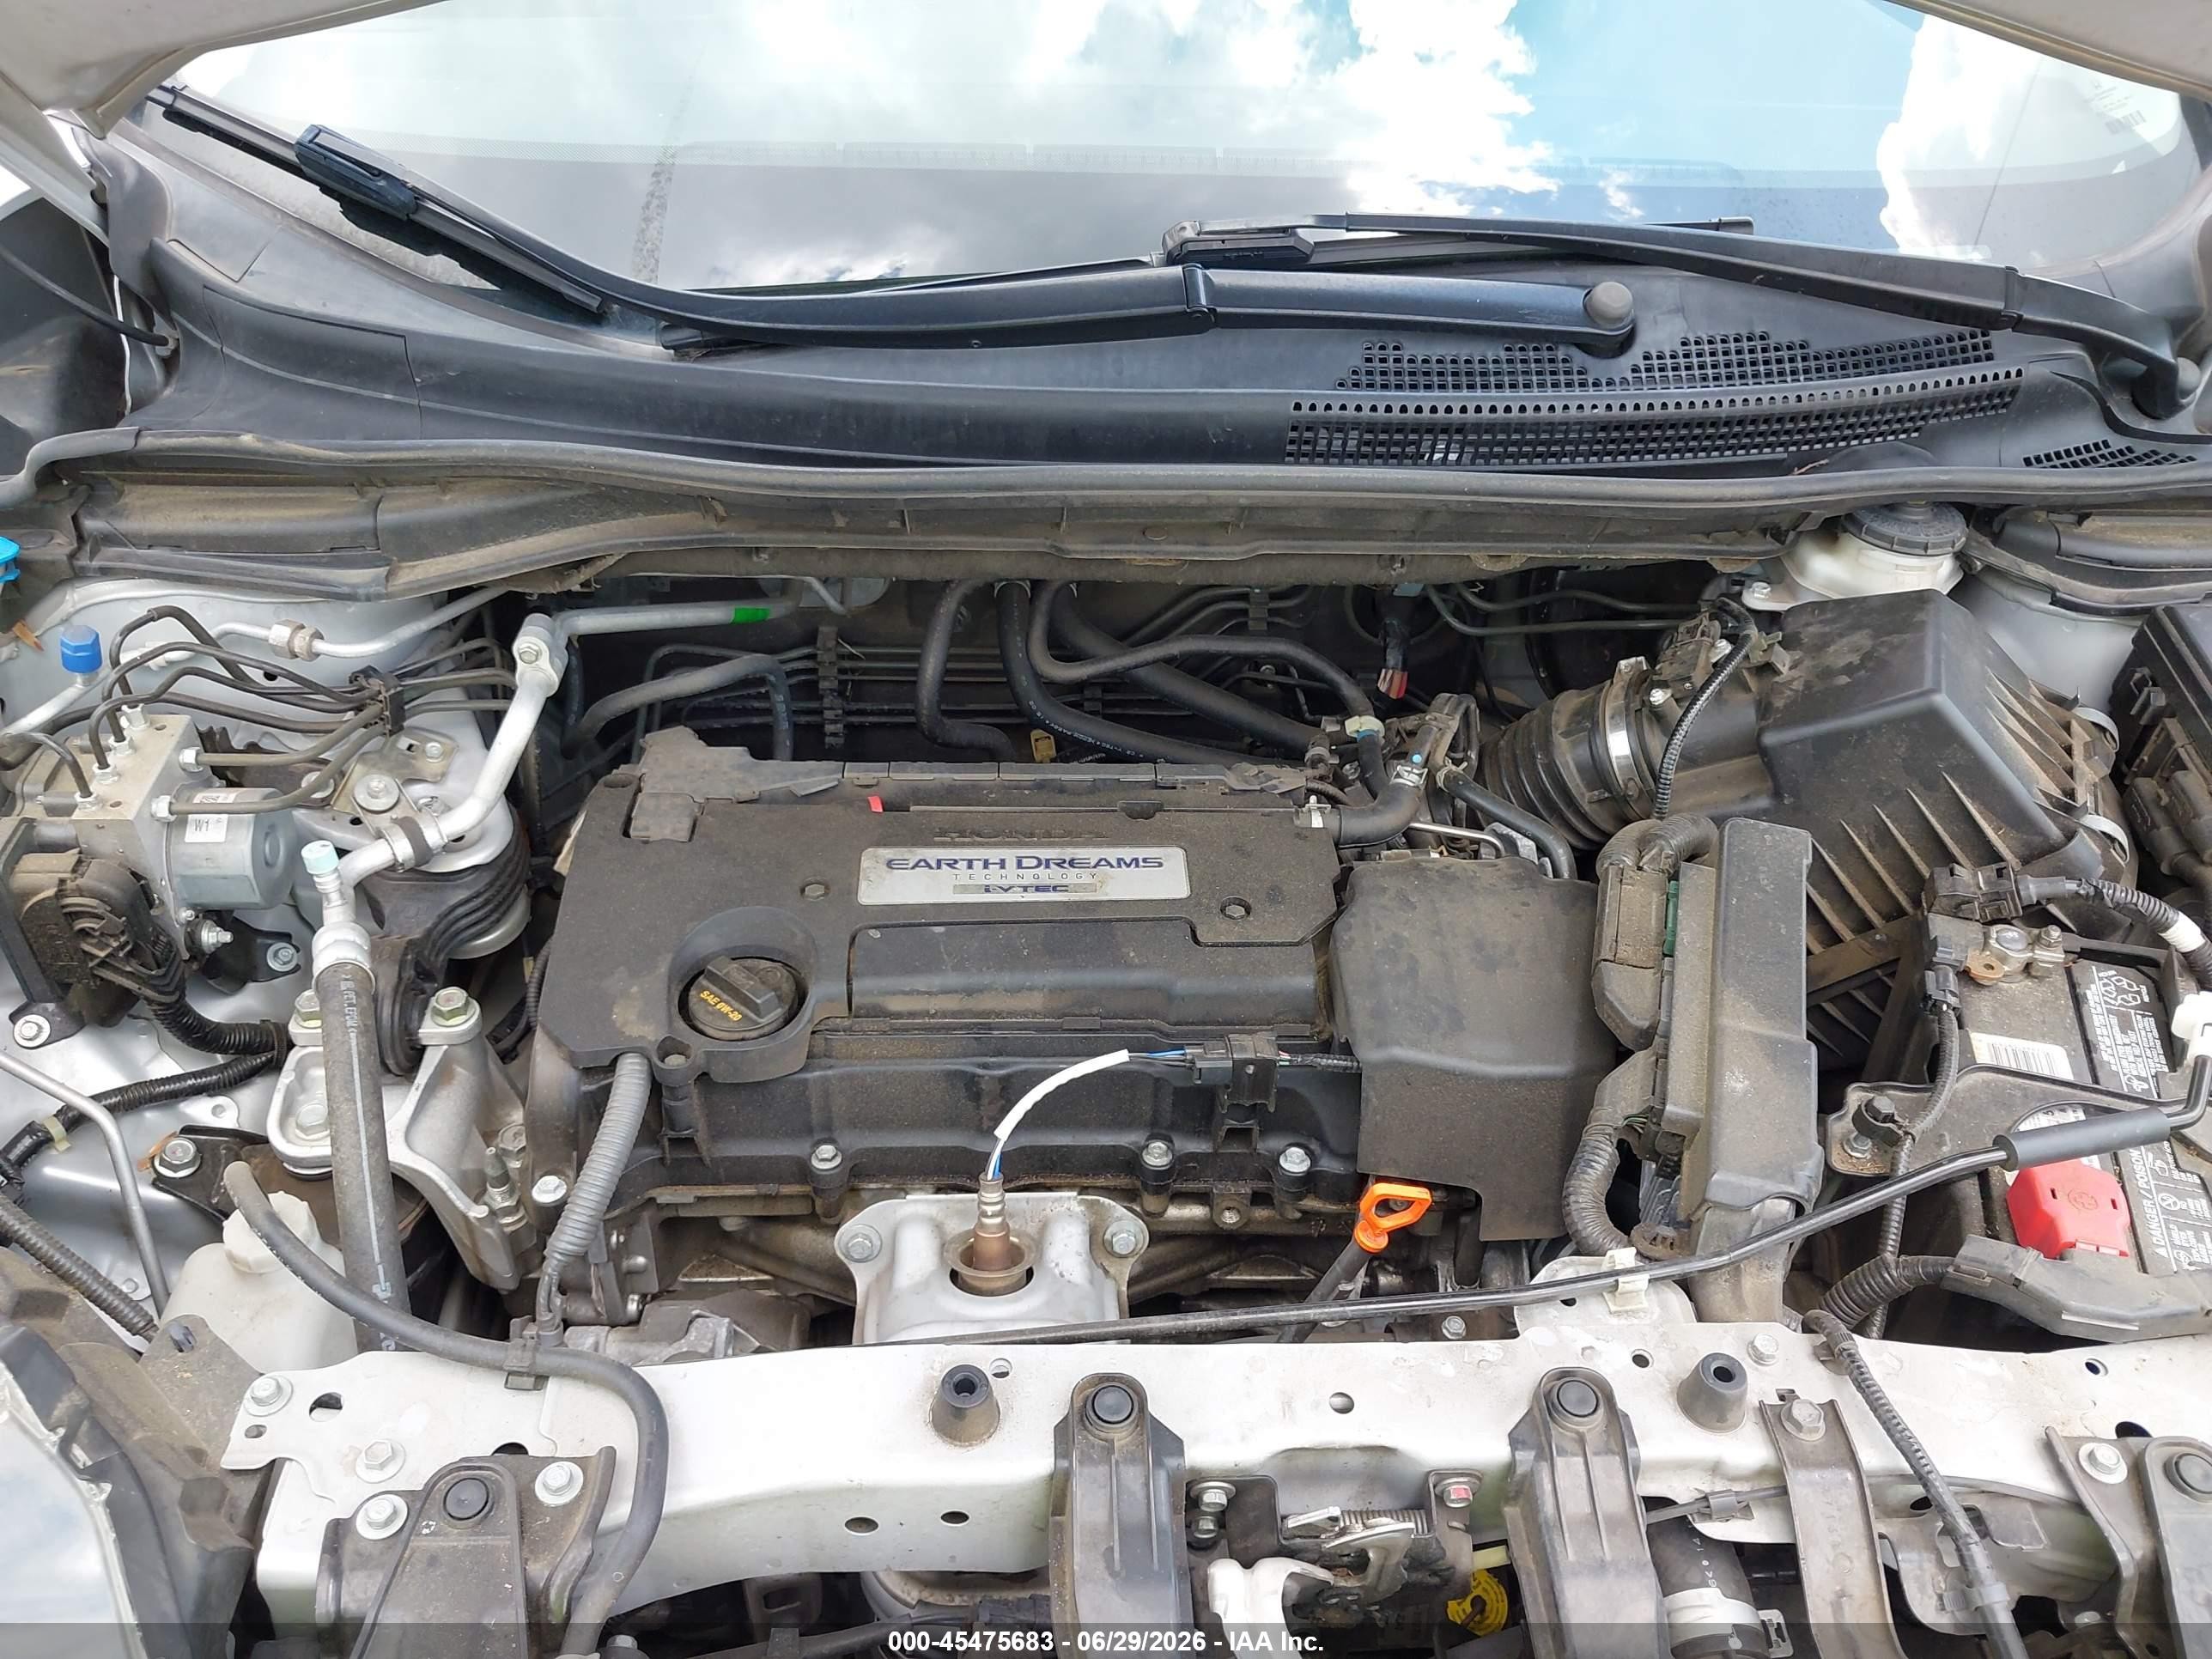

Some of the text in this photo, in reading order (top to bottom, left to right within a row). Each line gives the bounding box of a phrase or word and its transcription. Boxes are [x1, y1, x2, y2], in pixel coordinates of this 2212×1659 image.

[886, 854, 1164, 871] EARTH DREAMS
[954, 872, 1098, 881] TECHNOLOGY
[984, 884, 1069, 893] i-VTEC
[700, 990, 743, 1022] SAE 0W-20
